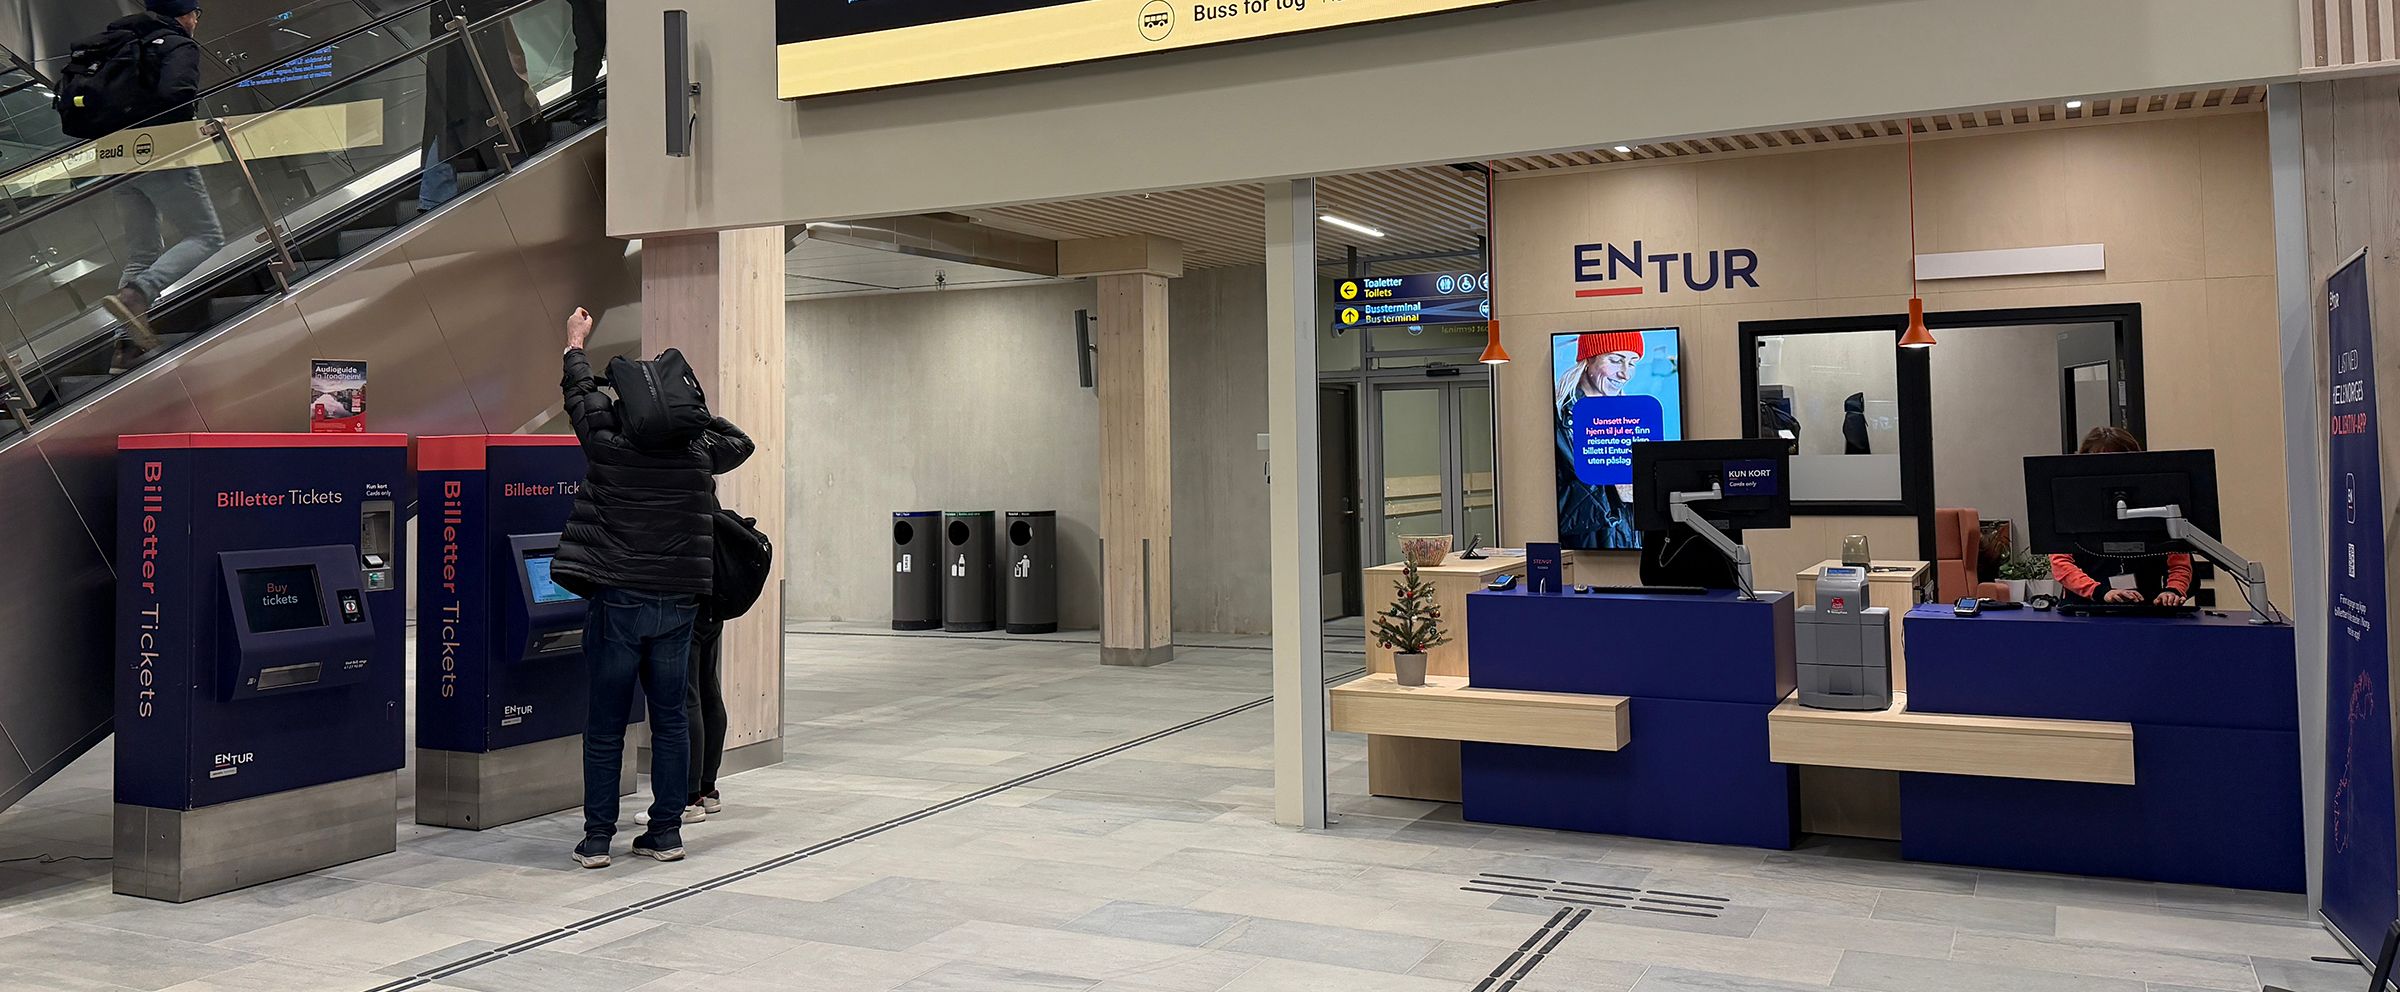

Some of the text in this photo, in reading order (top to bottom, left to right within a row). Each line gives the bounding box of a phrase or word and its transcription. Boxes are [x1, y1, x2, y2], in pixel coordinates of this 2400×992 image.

[1194, 4, 1237, 21] Buss
[1244, 0, 1268, 14] for
[1574, 240, 1759, 293] ENTUR
[1364, 278, 1402, 288] Toaletter
[1364, 288, 1392, 298] Toilets
[1366, 302, 1421, 313] Bussterminal
[1383, 314, 1419, 322] terminal
[1623, 417, 1640, 425] hvor
[1586, 428, 1604, 436] hjem
[1614, 427, 1623, 436] jul
[1606, 456, 1631, 466] påslag
[505, 481, 580, 496] Billetter Tick
[217, 489, 342, 507] Billetter Tickets
[140, 462, 162, 717] Billetter Tickets
[267, 583, 287, 593] Buy
[442, 481, 461, 697] Billetter Tickets
[262, 594, 298, 606] tickets
[505, 704, 533, 715] ENTUR
[215, 752, 254, 765] ENTUR
